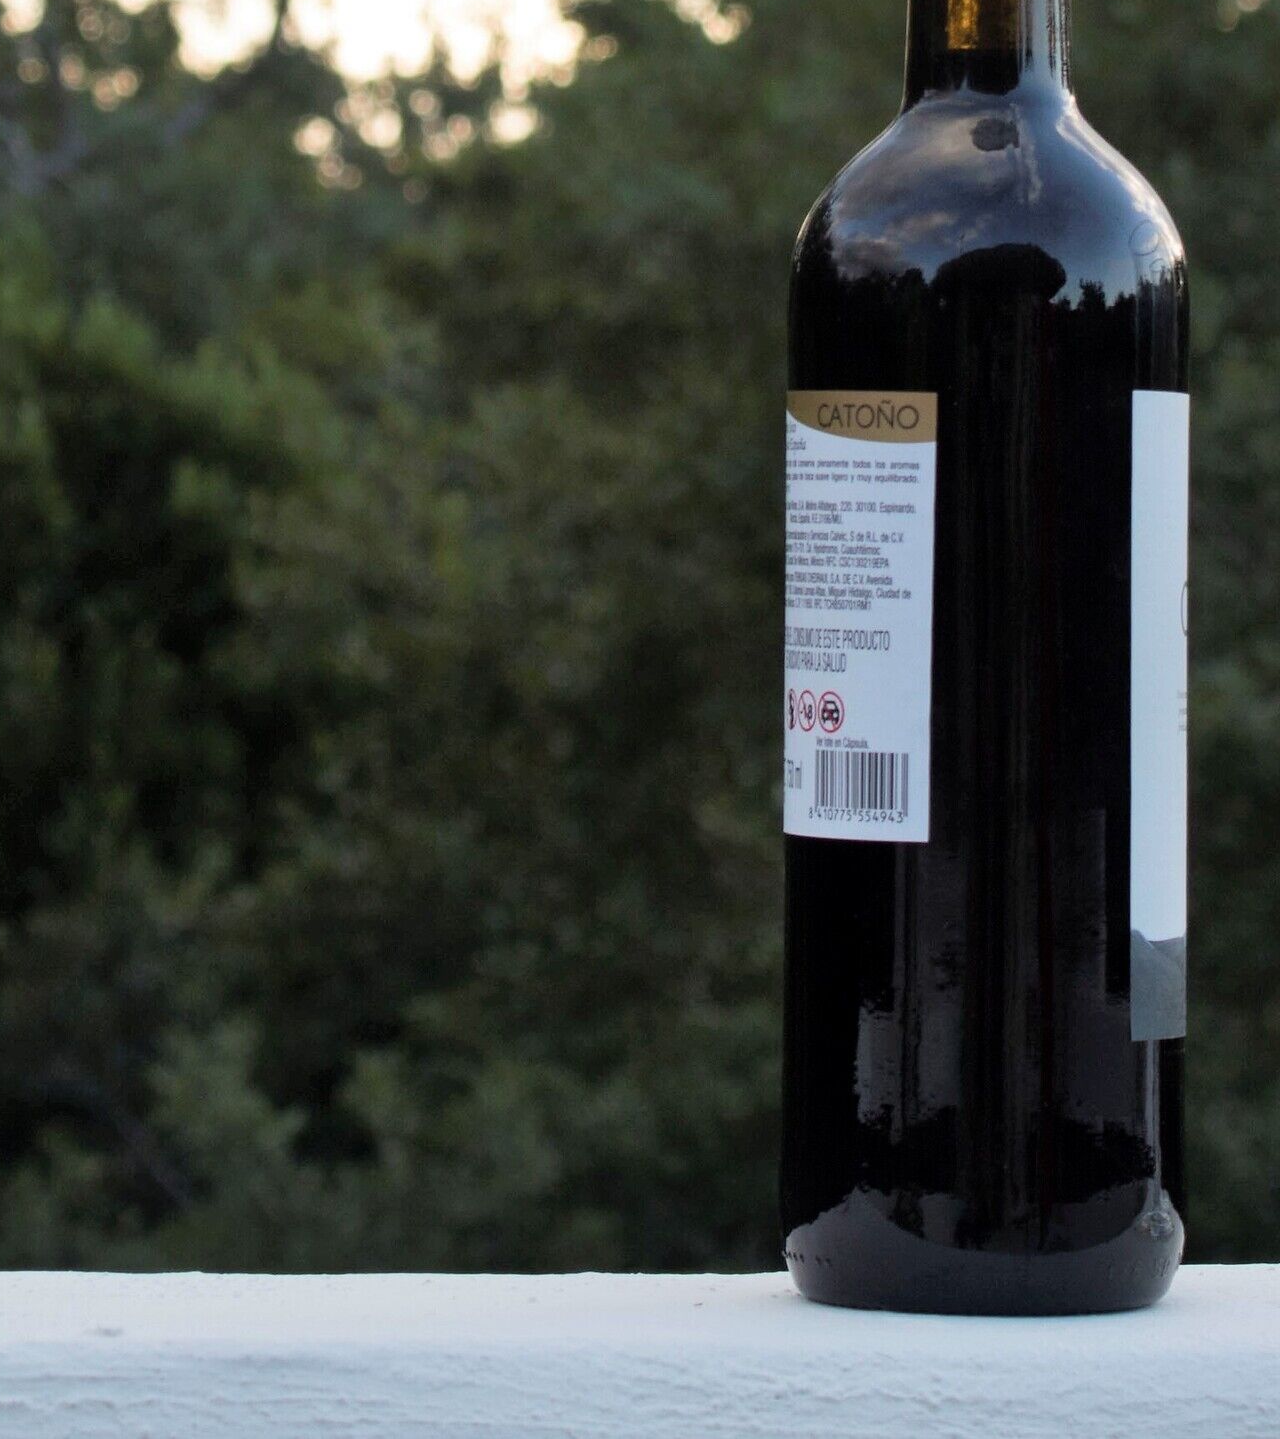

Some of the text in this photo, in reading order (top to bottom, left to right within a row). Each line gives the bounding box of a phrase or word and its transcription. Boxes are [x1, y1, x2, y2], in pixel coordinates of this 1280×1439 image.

[817, 400, 920, 430] CATOÑO
[857, 474, 872, 483] muy
[880, 532, 889, 543] de
[875, 587, 900, 599] Ciudad
[902, 588, 912, 600] de
[823, 628, 841, 649] ESTE
[842, 629, 891, 651] PRODUCTO
[823, 652, 847, 673] SALUD
